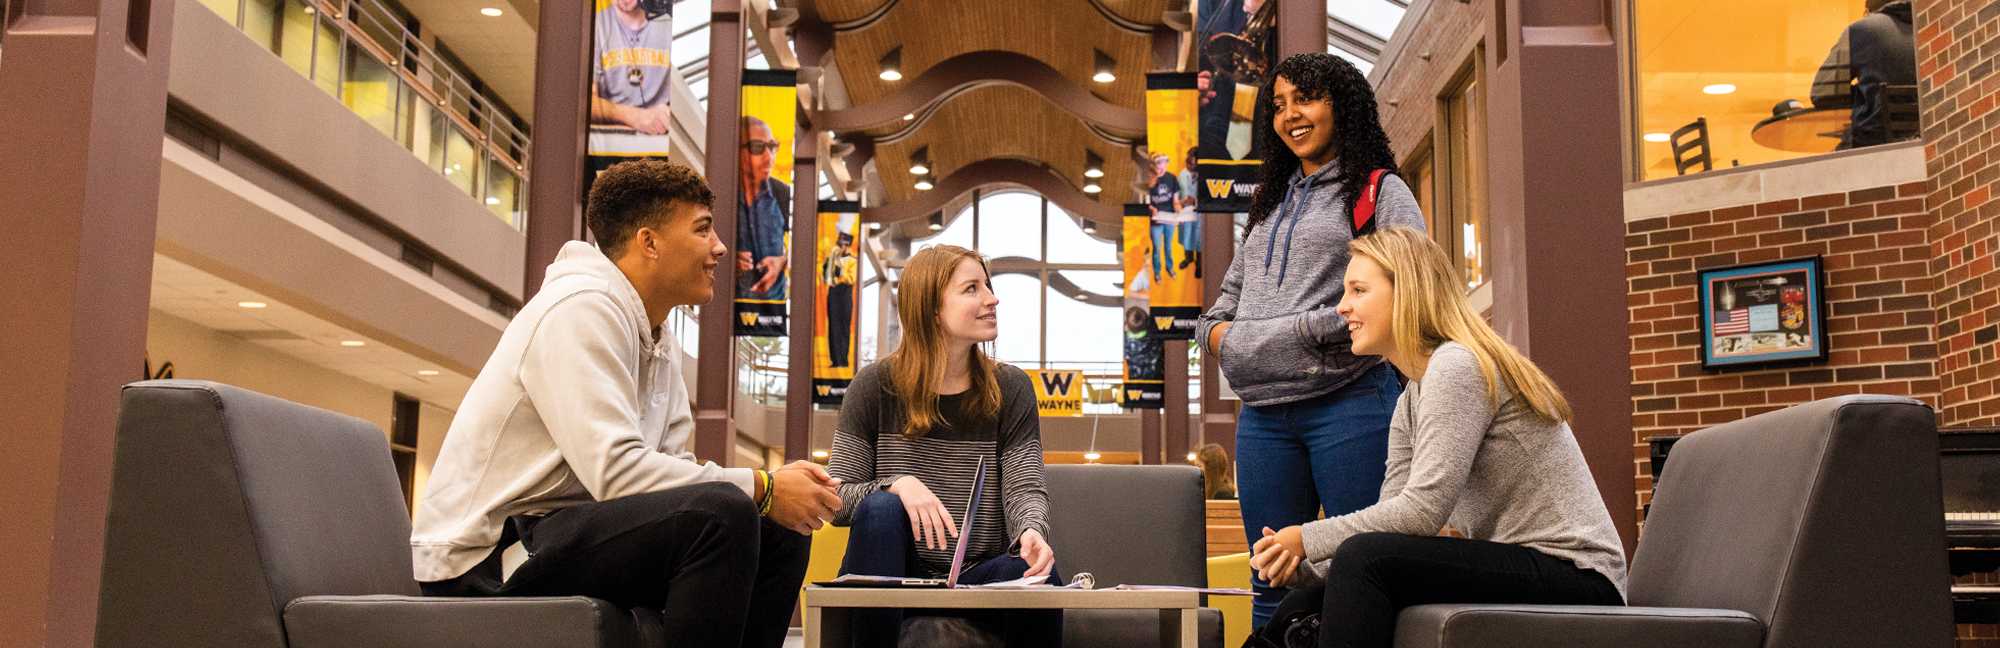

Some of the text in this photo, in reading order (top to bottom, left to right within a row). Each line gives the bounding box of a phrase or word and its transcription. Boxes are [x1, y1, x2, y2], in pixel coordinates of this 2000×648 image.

[1206, 179, 1257, 199] W WAY
[740, 312, 759, 326] W
[1155, 316, 1175, 331] W
[1040, 372, 1073, 396] W
[1038, 399, 1081, 410] WAYNE
